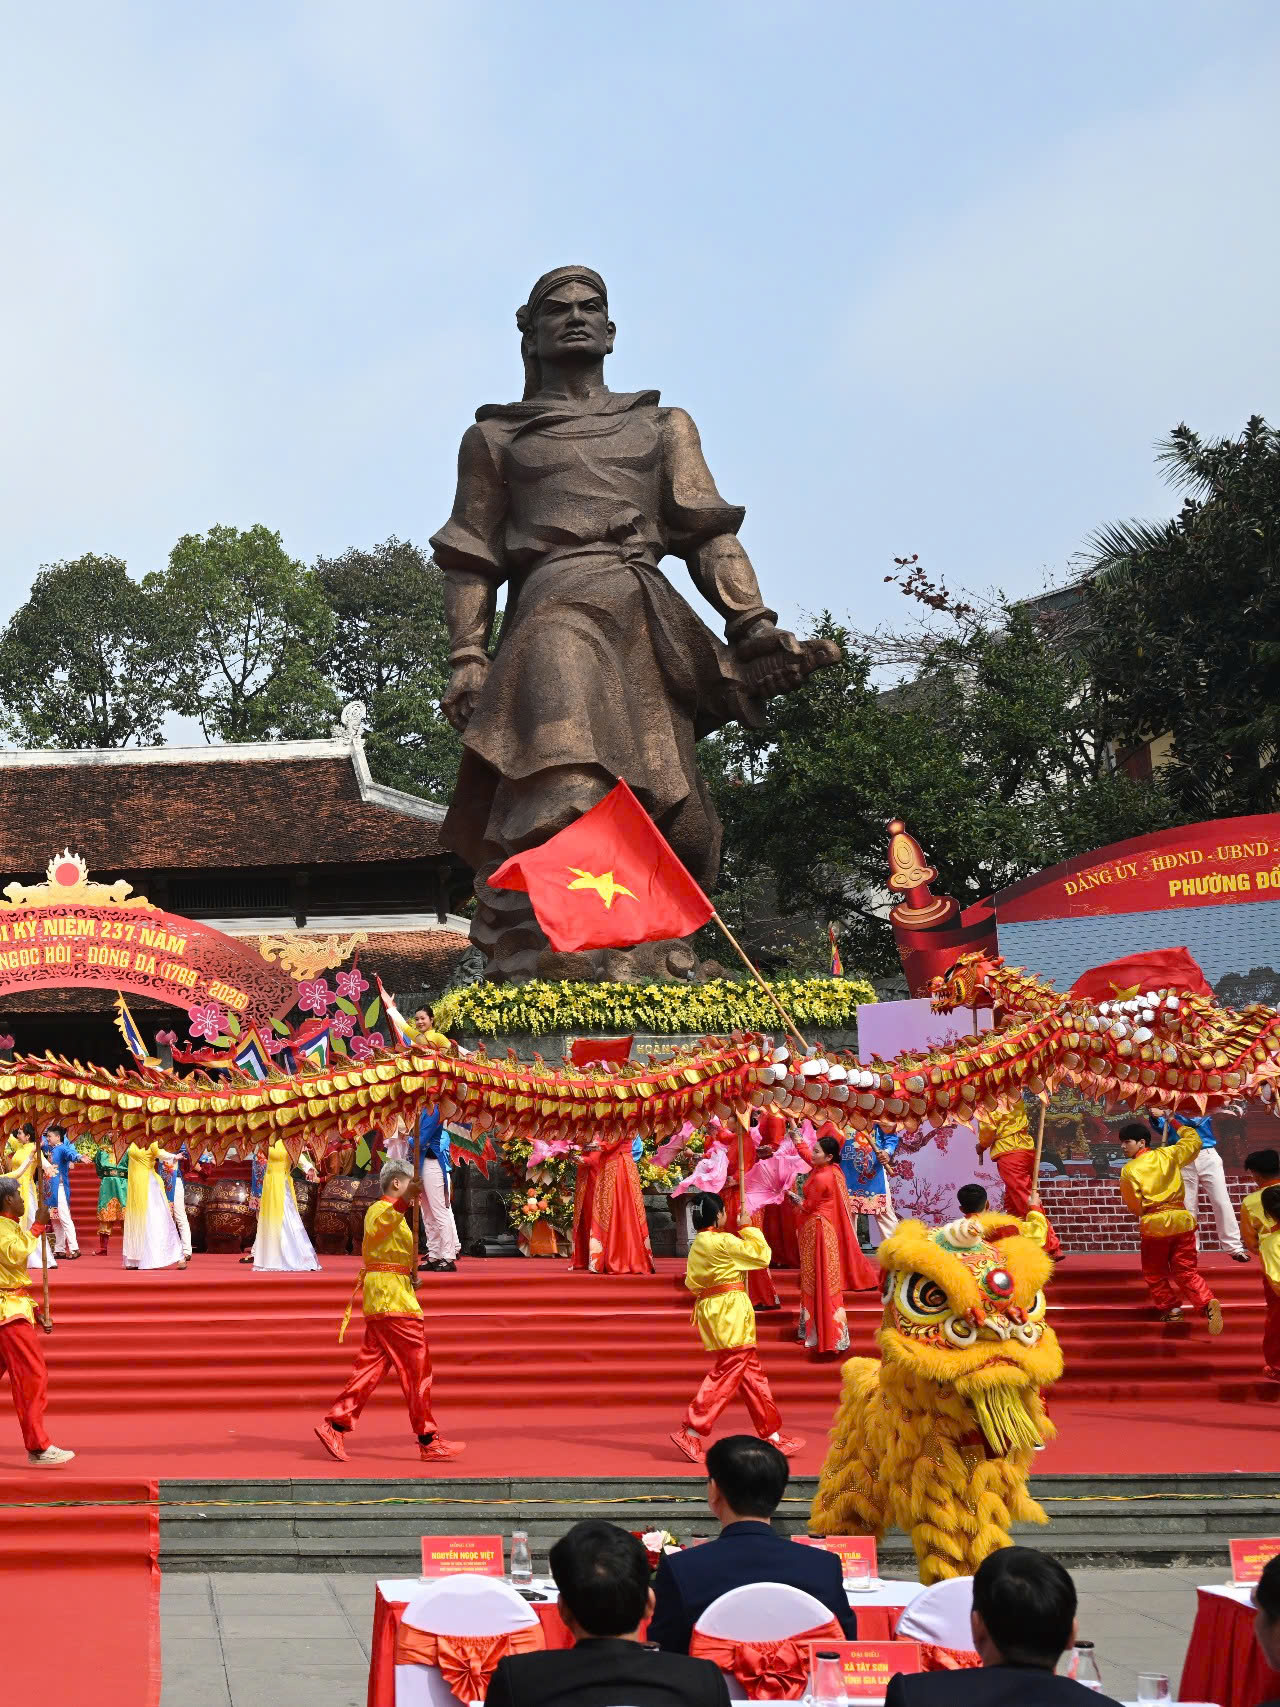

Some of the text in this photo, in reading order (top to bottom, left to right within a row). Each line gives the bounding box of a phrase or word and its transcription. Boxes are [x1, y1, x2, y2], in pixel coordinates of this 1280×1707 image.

[1064, 869, 1113, 896] ĐẢNG
[1116, 860, 1138, 880] ỦY
[1151, 850, 1203, 872] HĐND
[1217, 842, 1269, 861] UBND
[1168, 872, 1251, 898] PHƯỜNG
[13, 916, 37, 940] KỶ
[43, 915, 96, 940] NIỆM
[100, 920, 136, 942] 237
[139, 928, 187, 956] NĂM
[45, 942, 71, 964] HỒI
[88, 942, 130, 968] ĐỐNG
[135, 954, 156, 975] ĐA
[160, 961, 199, 988] (1789
[208, 980, 249, 1011] 2026)
[460, 1552, 479, 1560] NGỌC
[480, 1550, 495, 1560] VIỆT
